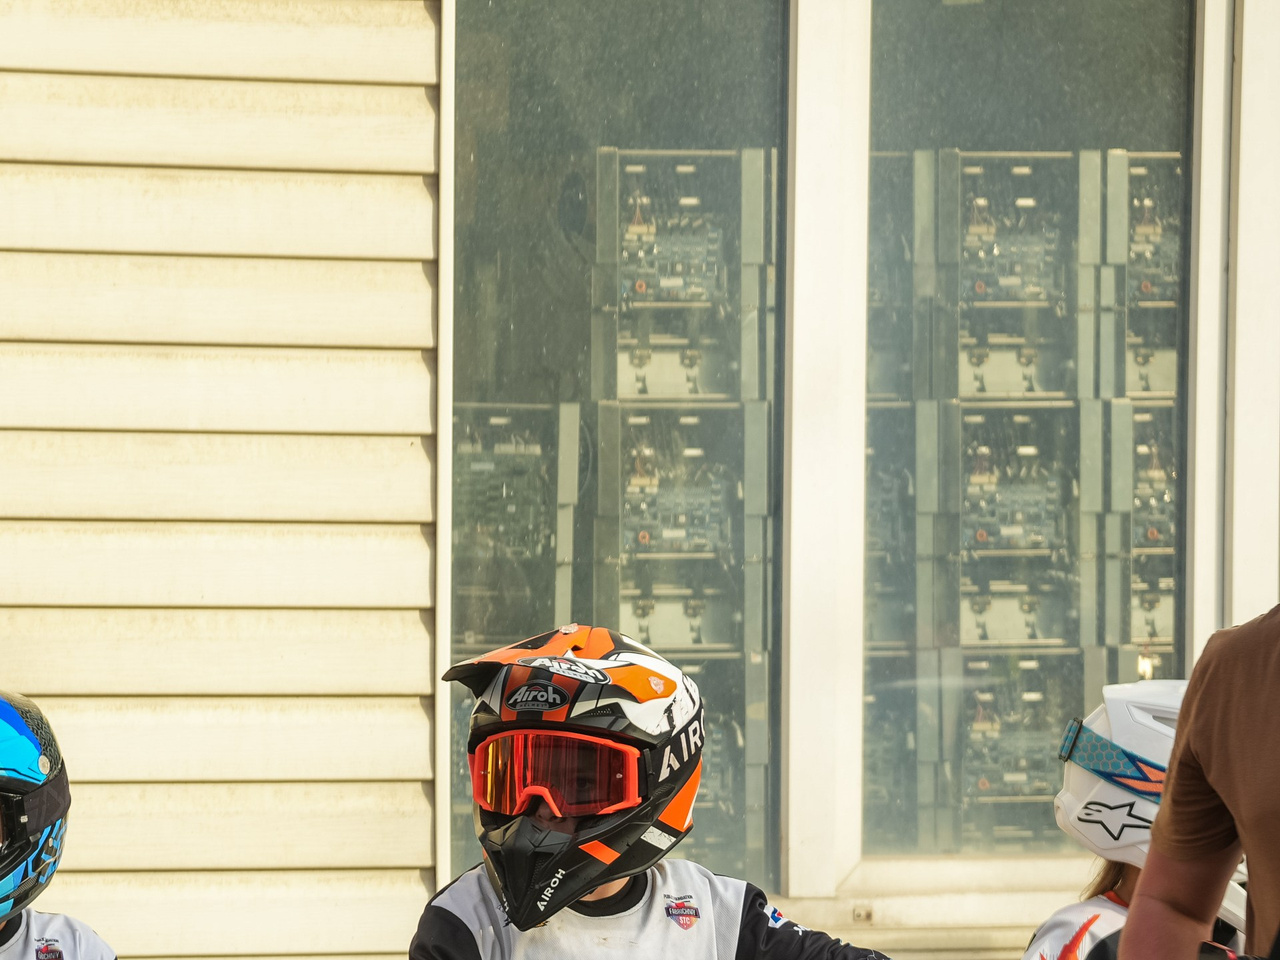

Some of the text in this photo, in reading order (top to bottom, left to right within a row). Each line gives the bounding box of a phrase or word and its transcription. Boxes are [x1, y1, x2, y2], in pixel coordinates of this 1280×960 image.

[508, 686, 561, 705] Airoh
[536, 867, 566, 912] AIROH
[679, 916, 691, 925] STC
